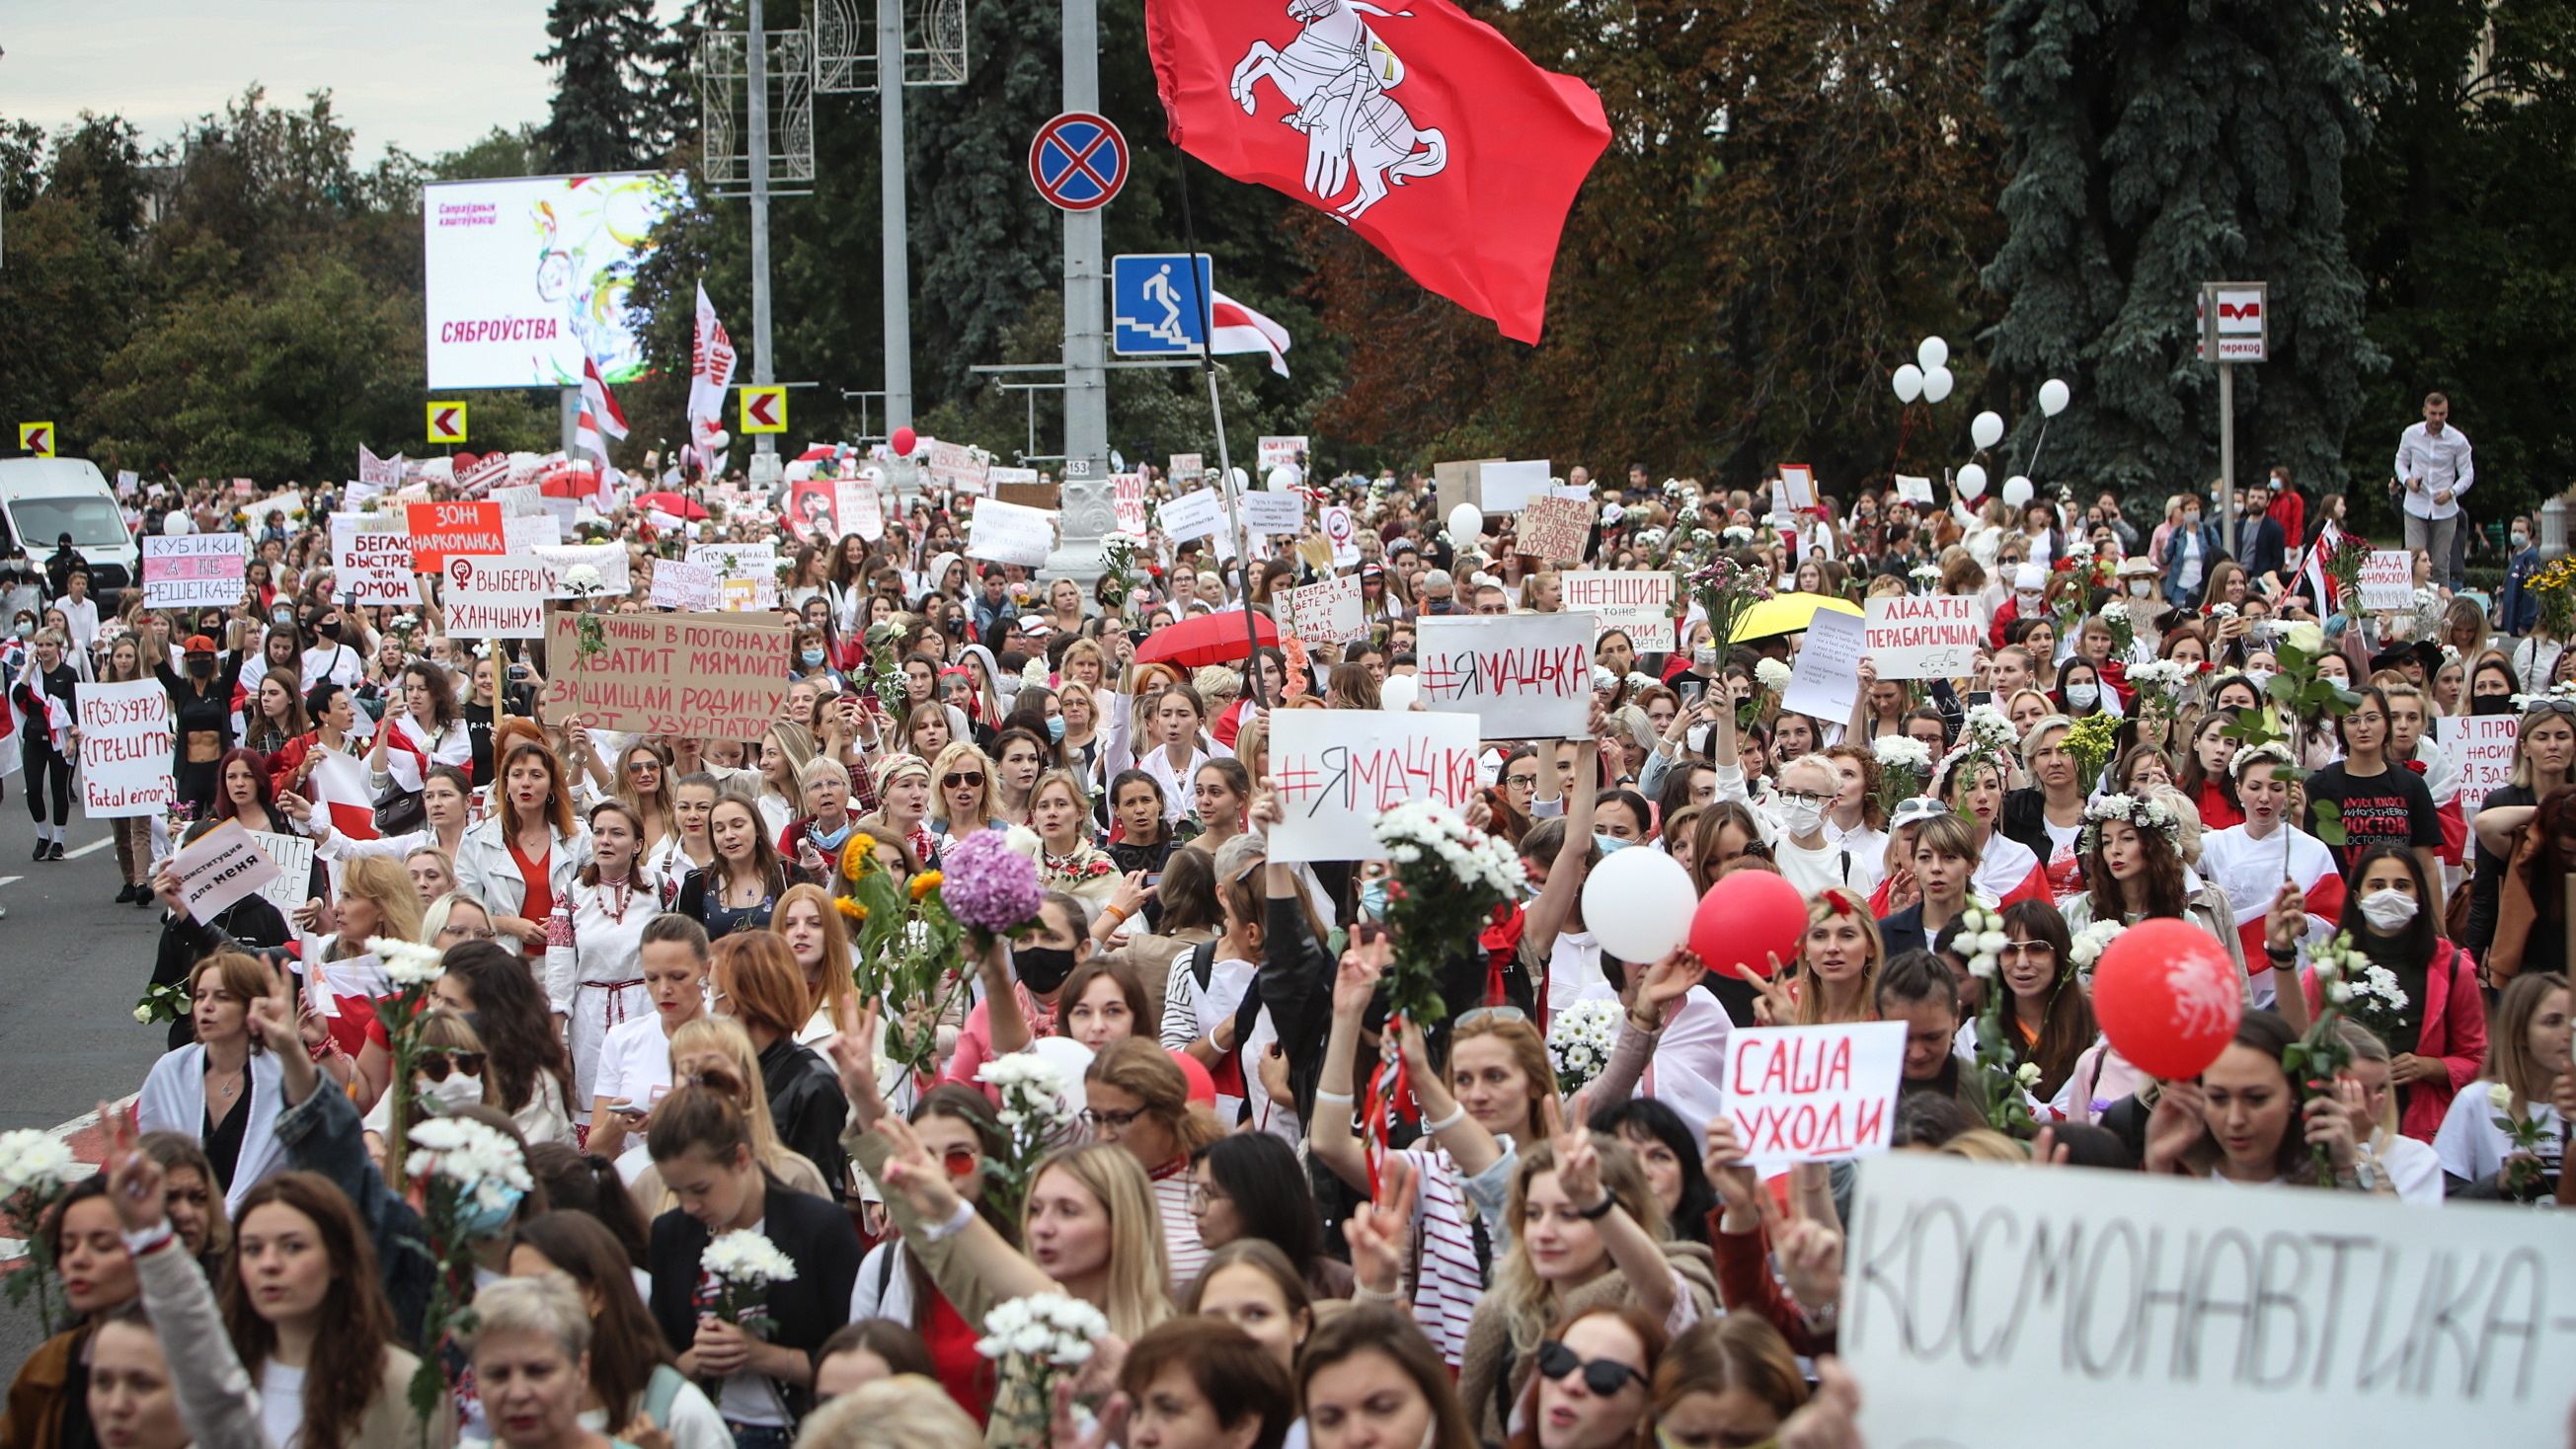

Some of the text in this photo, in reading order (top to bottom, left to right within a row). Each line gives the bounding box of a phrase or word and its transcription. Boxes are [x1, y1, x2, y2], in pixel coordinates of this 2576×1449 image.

[441, 317, 557, 343] СЯБРОЎСТВА
[2220, 343, 2260, 354] переход
[1069, 462, 1086, 473] 153
[1541, 496, 1587, 513] ВЕРЮ Я
[435, 504, 479, 527] ЗОЖ
[411, 532, 504, 553] НАРКОМАНКА
[165, 558, 223, 576] А НЕ
[346, 553, 412, 570] БЫСТРЕ
[369, 571, 395, 579] ЧЕМ
[476, 569, 542, 592] ВЫБЕРЫ
[353, 581, 409, 599] ОМОН
[1296, 583, 1334, 598] ВСЕГДА
[1341, 579, 1348, 588] В
[1570, 578, 1670, 606] ЖЕНЩИН
[1281, 597, 1321, 613] ОВЕТЕ
[1329, 593, 1342, 603] ЗА
[1602, 607, 1637, 617] тоже
[449, 603, 542, 631] ЖАНЧЫНУ!
[1283, 607, 1333, 624] ЧМУ НЕ
[558, 617, 655, 641] МЧИНЫ
[664, 625, 678, 644] В
[1281, 620, 1333, 637] ПТАЛСЯ
[1634, 628, 1673, 648] зете?
[1866, 624, 1978, 648] ПЕРАБАРШЧЫЛА
[569, 647, 789, 678] ХВАТИТ МЯМЛИТЬ
[1421, 644, 1591, 703] #ЯМАЦЬКА
[549, 679, 783, 717] ЗАЩИЩАЙ РОДИНУ
[580, 712, 771, 738] ОТ УЗУРПАТОР
[2457, 718, 2517, 739] Я ПРО
[2466, 745, 2514, 759] НАСИЛ
[2459, 763, 2512, 784] Я ЗДЕ
[2346, 835, 2382, 846] OCTOR
[190, 855, 259, 903] для меня
[1734, 1036, 1850, 1096] САША
[1735, 1098, 1884, 1156] УХОДИ
[1854, 1193, 2544, 1402] КОСМОНАВТИКА
